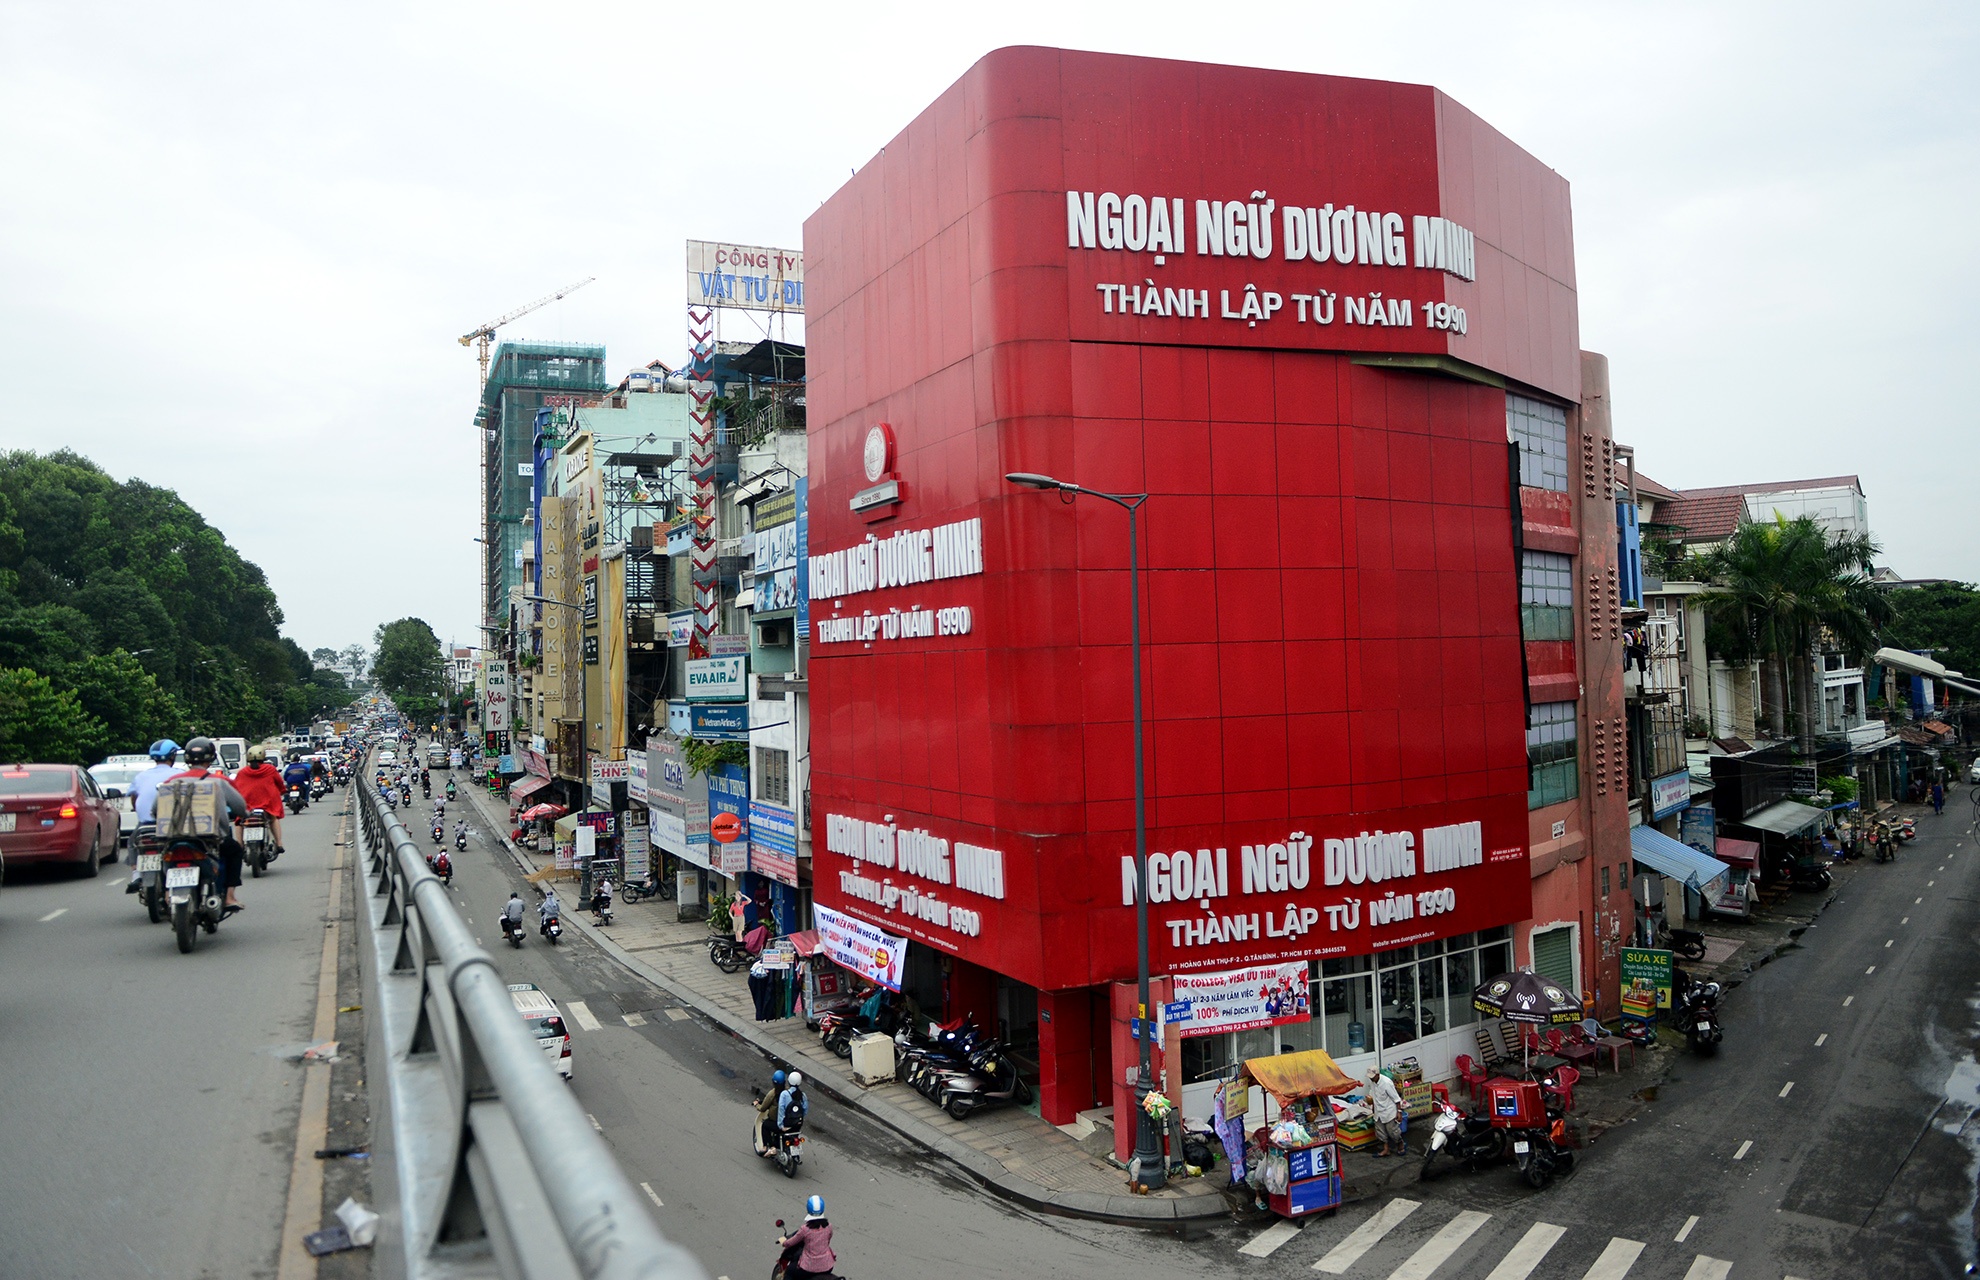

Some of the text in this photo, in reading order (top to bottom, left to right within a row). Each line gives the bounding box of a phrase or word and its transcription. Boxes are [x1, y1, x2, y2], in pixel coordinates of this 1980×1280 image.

[1067, 190, 1476, 282] NGOẠI NGỮ DƯƠNG MINH
[715, 248, 795, 271] CÔNG TY
[699, 266, 736, 303] VẬT
[742, 274, 769, 303] TƯ
[783, 280, 804, 305] ĐI
[1097, 278, 1468, 336] THÀNH LẬP TỪ NĂM 1990
[861, 492, 881, 505] Since 1990
[808, 550, 847, 609] NGOẠI
[847, 533, 878, 594] NGỮ
[879, 529, 933, 589] DƯƠNG
[933, 518, 983, 580] MINH
[817, 604, 972, 648] THÀNH LẬP TỪ NĂM 1990
[490, 662, 505, 672] BÚN
[489, 674, 504, 684] CHÀ
[602, 768, 620, 778] HN
[826, 814, 866, 868] NGOẠI
[866, 814, 896, 868] NGỮ
[898, 828, 951, 884] DƯƠNG
[954, 842, 1004, 899] MINH
[1122, 821, 1482, 910] NGOẠI NGỮ DƯƠNG MINH
[839, 868, 876, 902] THÀNH
[876, 878, 899, 914] LẬP
[900, 885, 918, 916] TỪ
[918, 892, 948, 927] NĂM
[950, 906, 980, 937] 1990
[1166, 888, 1456, 948] THÀNH LẬP TỪ NĂM 1990
[1280, 950, 1302, 958] TP.HCM
[1627, 952, 1667, 964] SỬA XE
[1228, 974, 1244, 984] VISA
[1212, 993, 1225, 1002] NĂM
[1227, 991, 1240, 1000] LÀM
[1240, 990, 1254, 998] VIỆC
[1196, 1005, 1259, 1020] 100% PHÍ DỊCH VỤ
[1189, 1026, 1210, 1034] HOÀNG
[1223, 1024, 1232, 1032] THỤ
